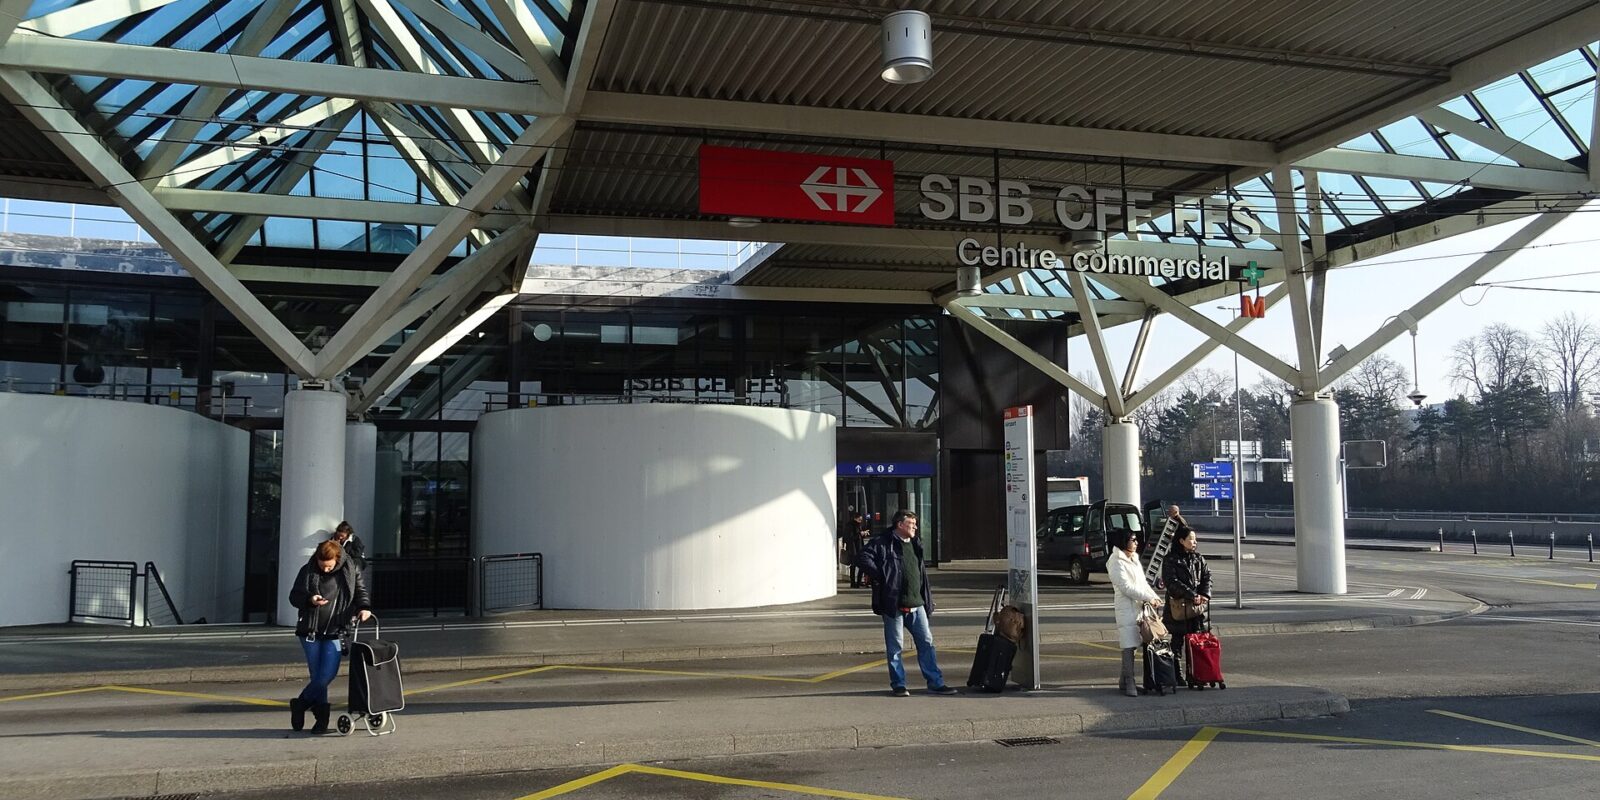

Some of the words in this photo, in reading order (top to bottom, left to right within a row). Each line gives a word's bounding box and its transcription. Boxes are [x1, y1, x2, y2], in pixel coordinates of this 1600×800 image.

[919, 173, 1034, 225] SBB
[1055, 185, 1154, 232] CFF
[1172, 196, 1262, 243] FFS
[958, 238, 1057, 270] Centre
[1073, 251, 1230, 281] commercial
[1240, 295, 1266, 319] M
